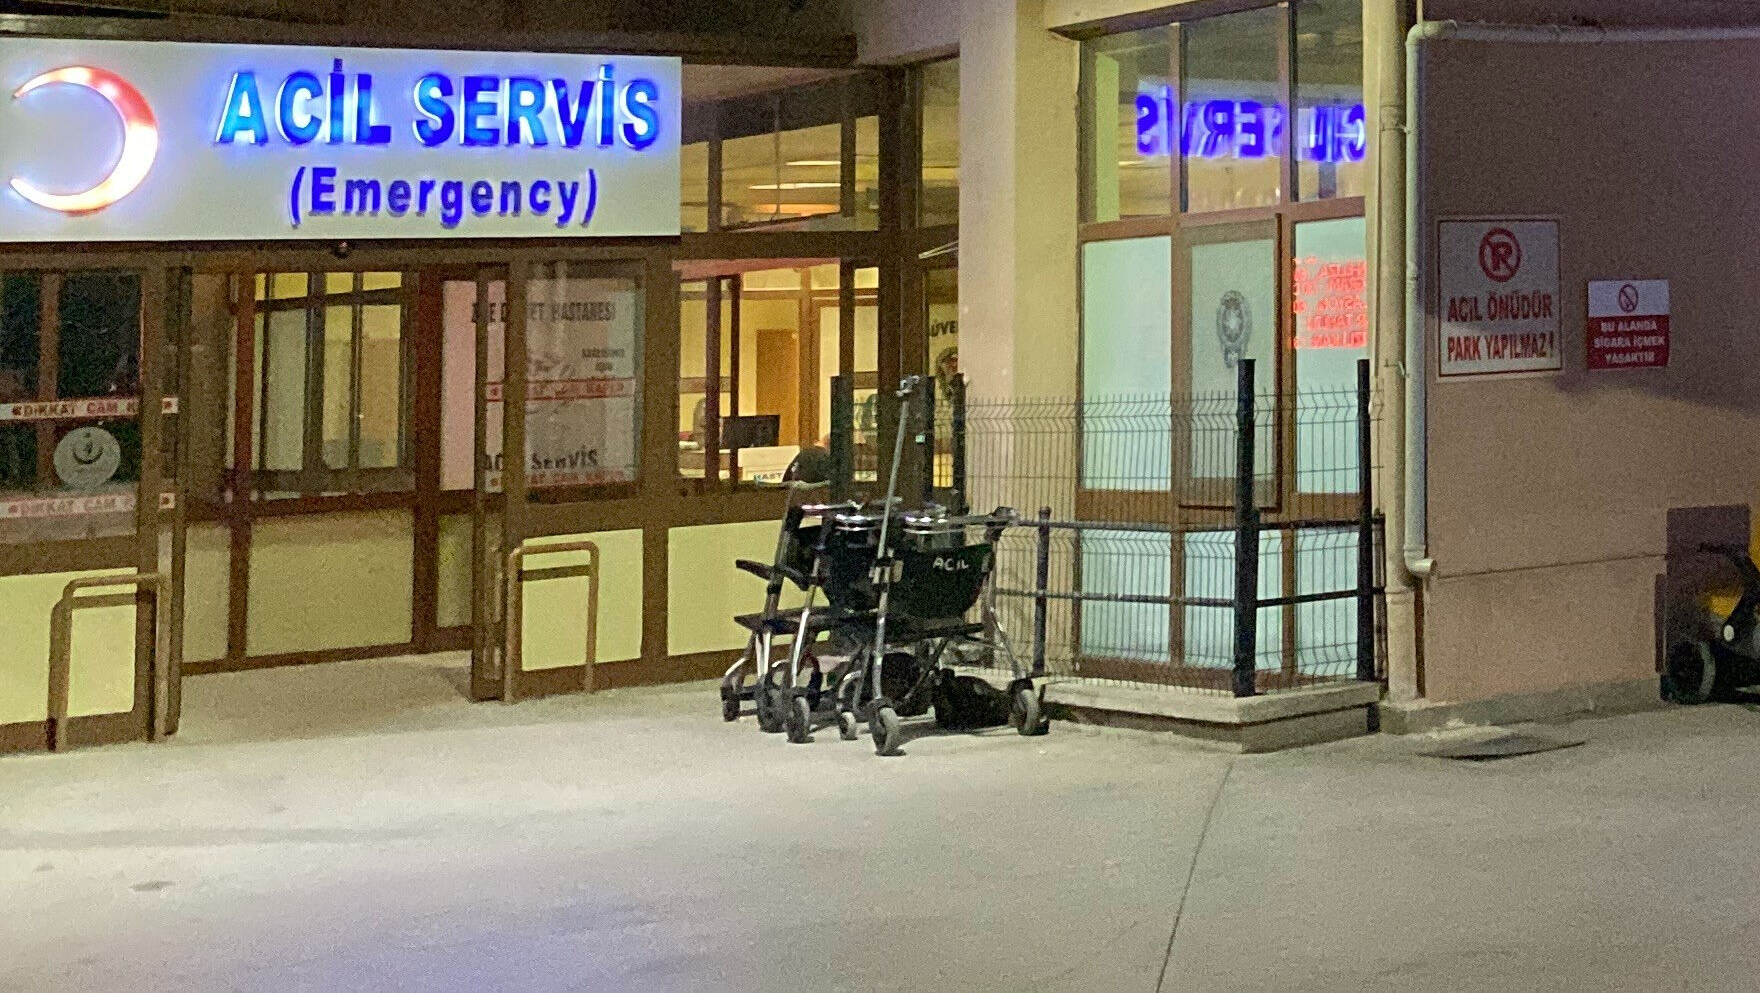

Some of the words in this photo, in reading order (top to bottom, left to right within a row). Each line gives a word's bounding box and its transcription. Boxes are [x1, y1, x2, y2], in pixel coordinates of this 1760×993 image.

[215, 58, 392, 146] ACİL
[412, 63, 660, 151] SERVİS
[289, 166, 598, 229] (Emergency)
[1447, 335, 1481, 361] PARK
